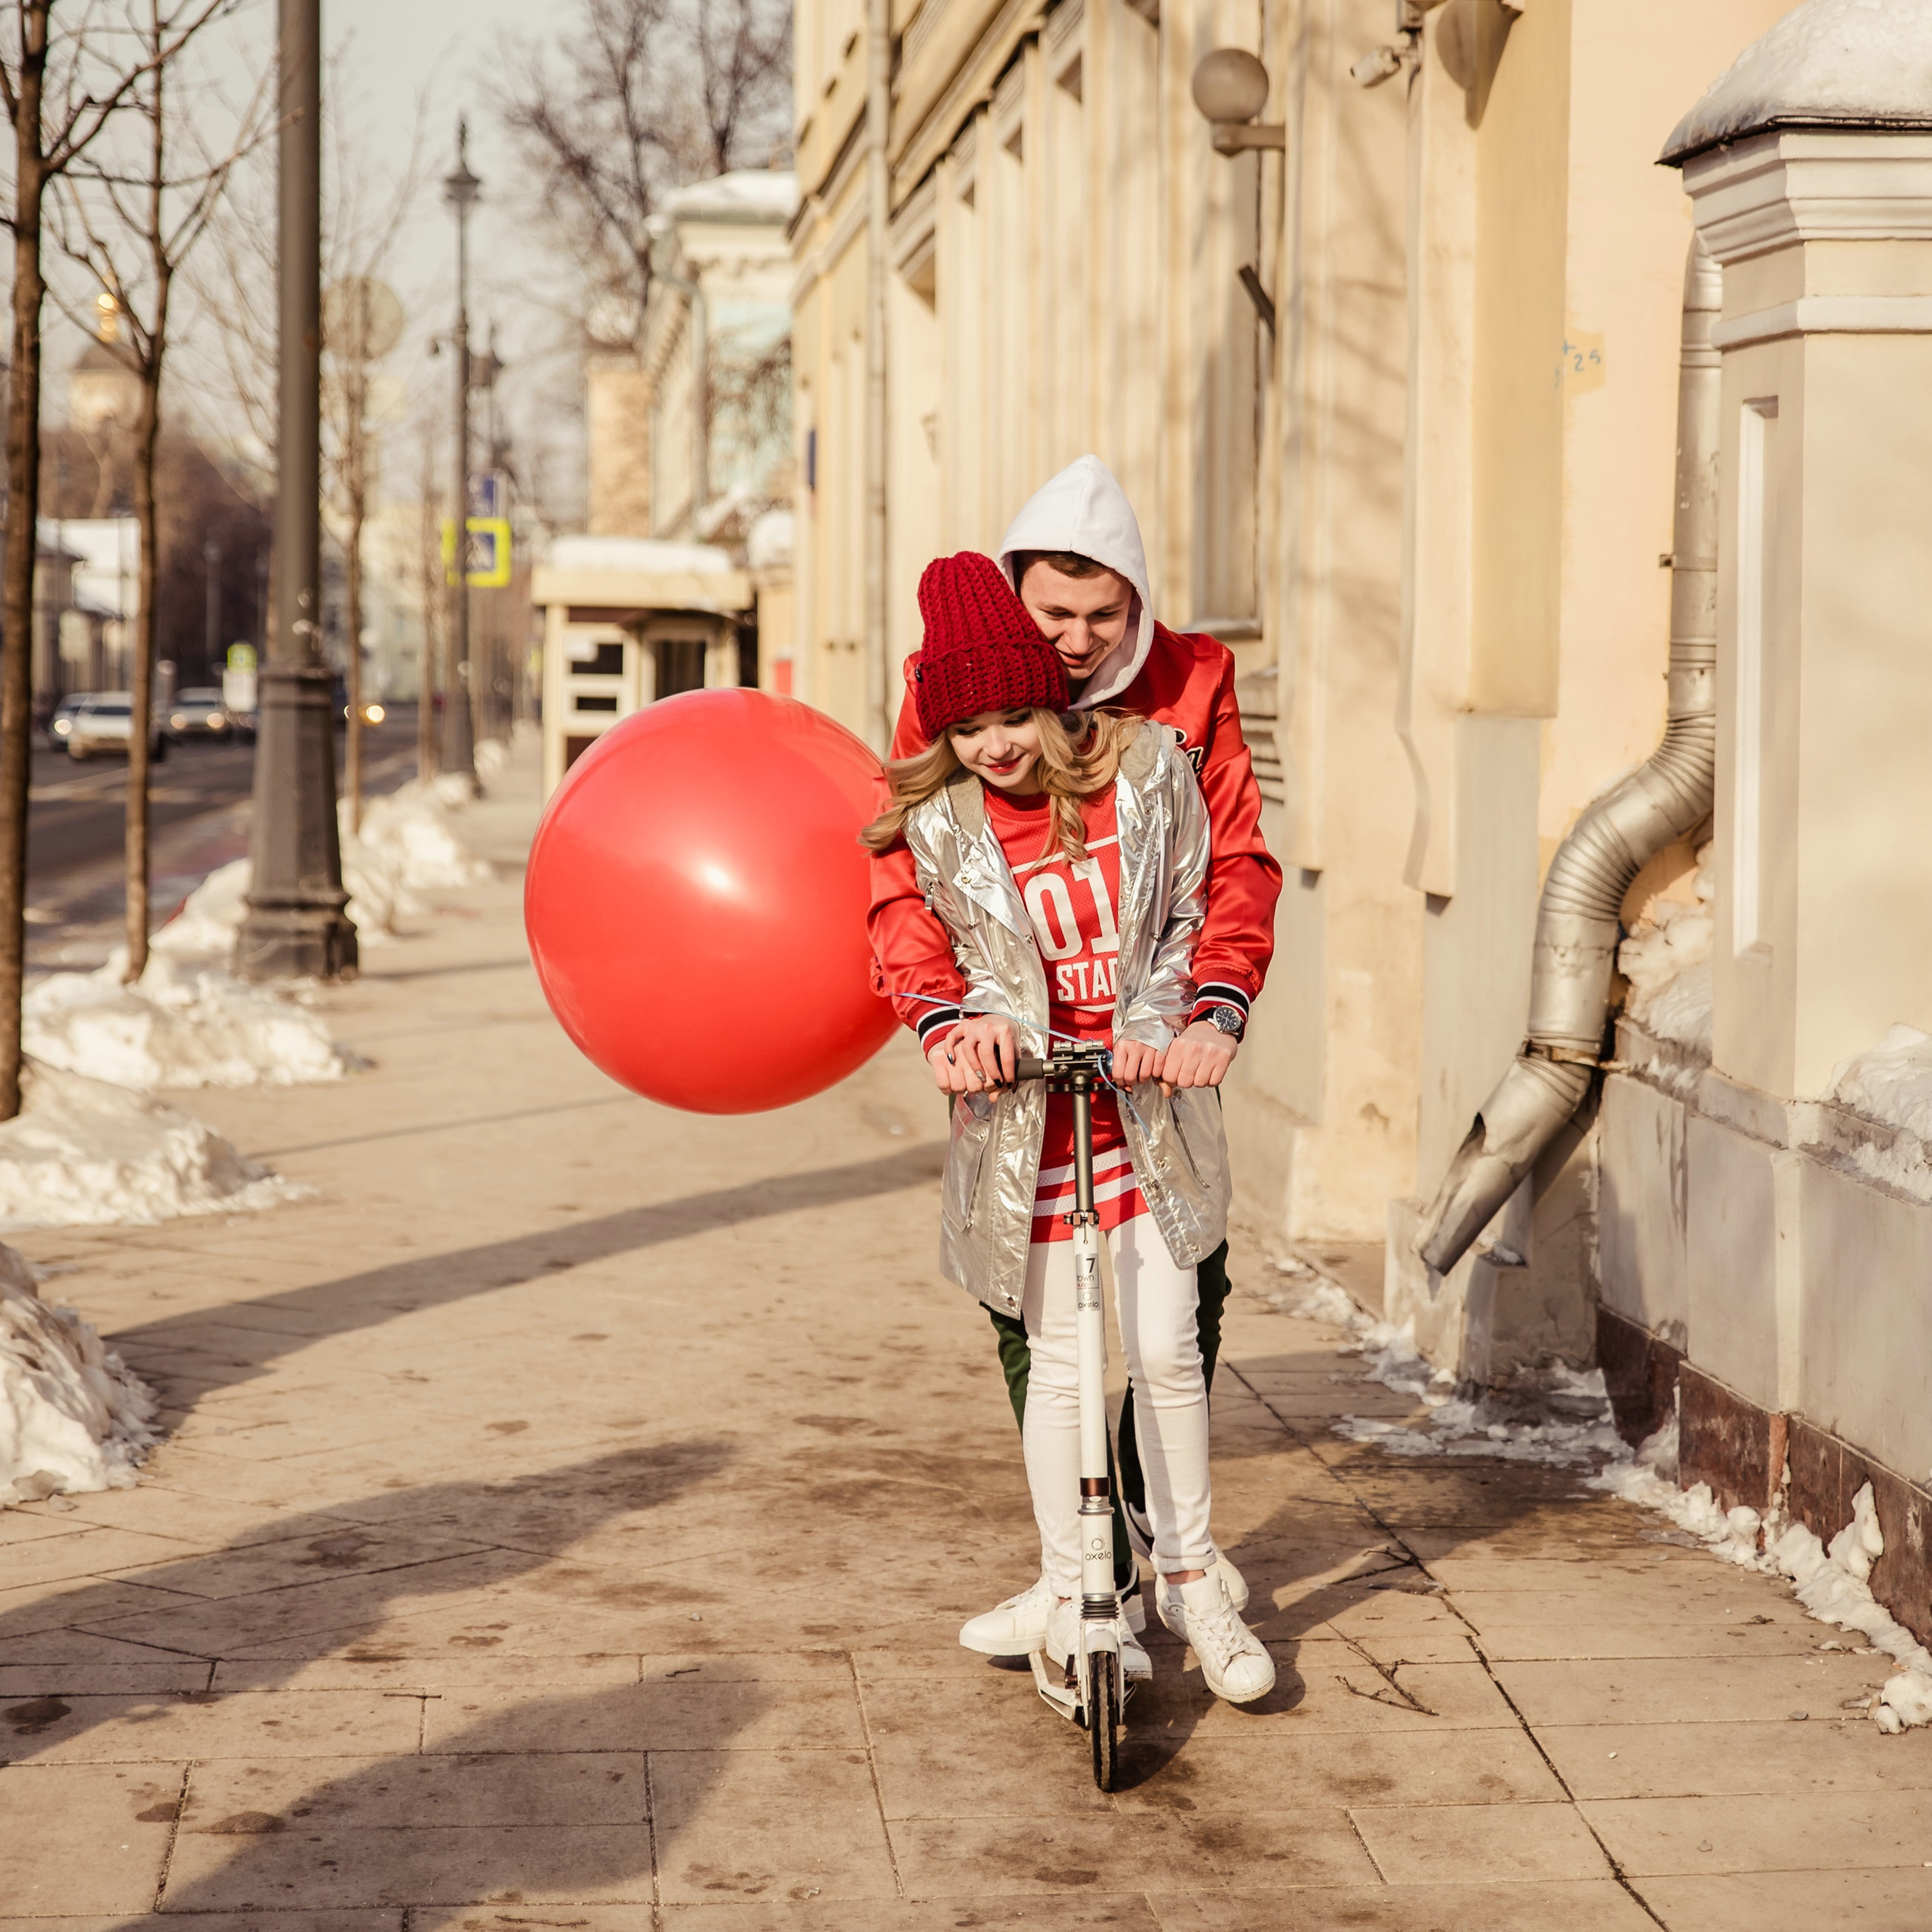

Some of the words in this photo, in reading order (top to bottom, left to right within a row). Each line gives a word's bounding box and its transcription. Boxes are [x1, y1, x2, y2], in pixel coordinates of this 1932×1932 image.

[1086, 1257, 1095, 1273] 7
[1078, 1300, 1099, 1309] oxelo
[1085, 1550, 1112, 1561] oxelo
